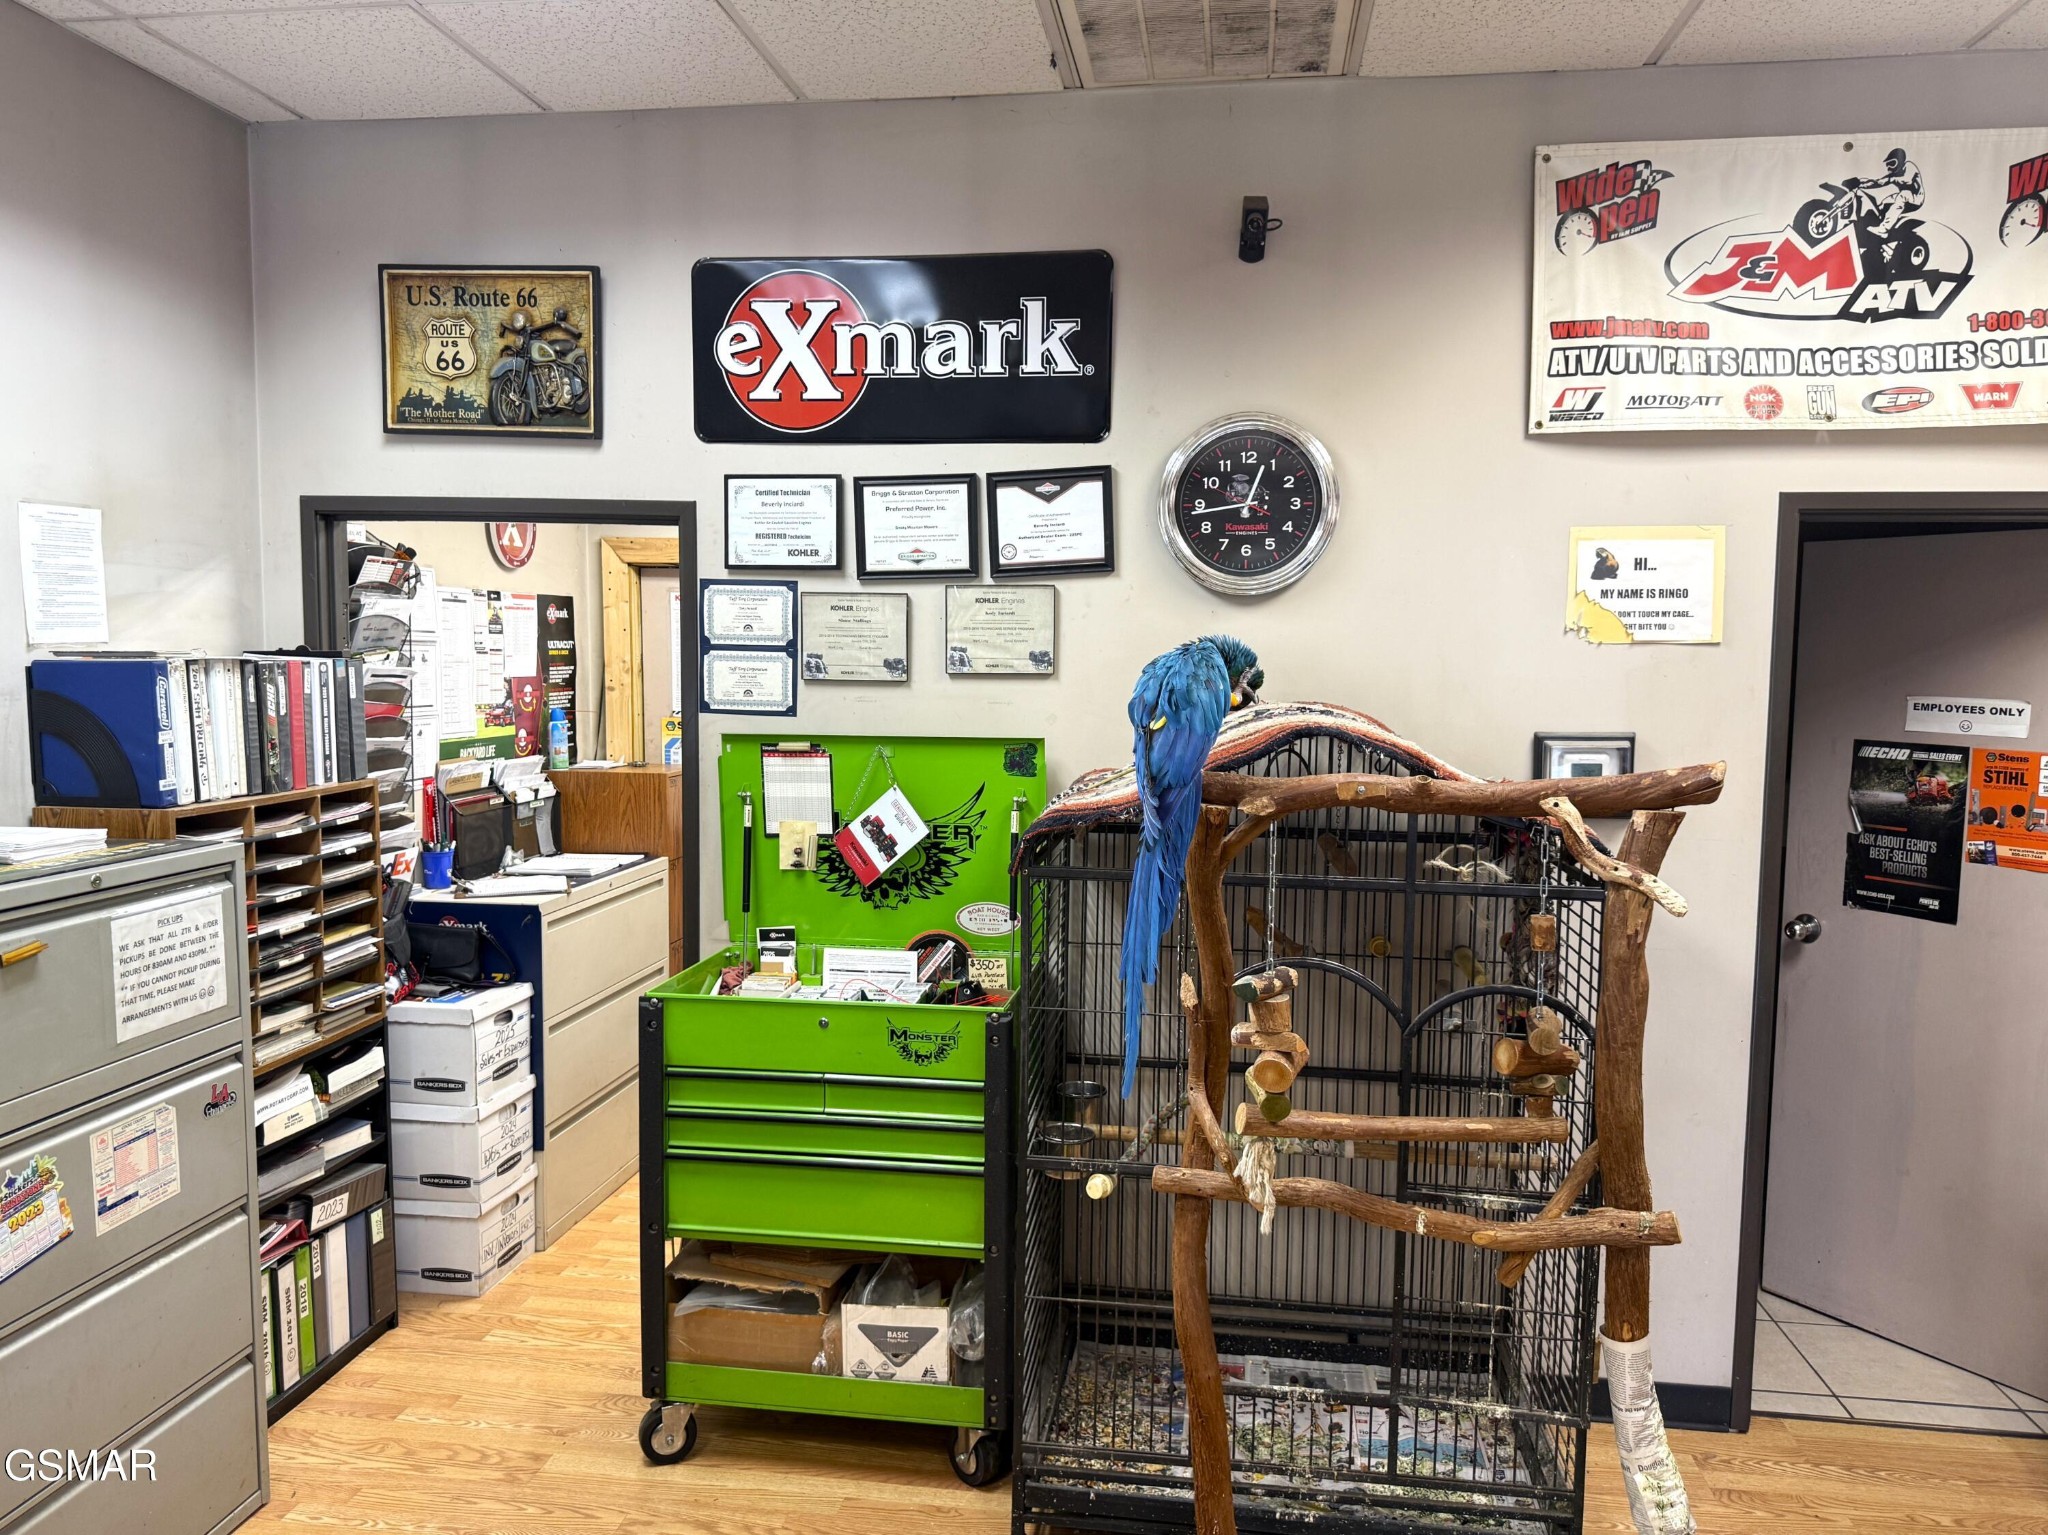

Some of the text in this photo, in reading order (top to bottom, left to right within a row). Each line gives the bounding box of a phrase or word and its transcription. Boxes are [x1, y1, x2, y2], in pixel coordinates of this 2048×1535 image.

[1556, 162, 1636, 215] Wide
[1631, 222, 1653, 233] SUPPLY
[1682, 234, 1860, 296] J&M
[405, 285, 538, 308] U.S. Route 66
[1849, 280, 1956, 315] ATV
[1550, 316, 1710, 340] www.jmatv.com
[1967, 308, 2048, 333] 1-800-3
[431, 324, 465, 336] ROUTE
[440, 340, 459, 348] US
[714, 297, 1085, 402] eXmark
[436, 351, 465, 371] 66
[1547, 336, 2048, 378] ATV/UTV PARTS AND ACCESSORIES SOLD
[1625, 395, 1724, 410] MOTOBATT
[1749, 394, 1777, 403] NGK
[1807, 391, 1836, 415] GUN
[1871, 392, 1931, 408] EPI
[1973, 392, 2009, 402] WARN
[400, 407, 485, 419] "The Mother Road"
[1240, 451, 1257, 463] 12
[1219, 460, 1231, 472] 11
[1270, 459, 1276, 471] 1
[1203, 477, 1219, 489] 10
[1283, 476, 1295, 488] 2
[871, 490, 891, 498] Briggs
[924, 488, 959, 497] Corporation
[1195, 499, 1206, 512] 9
[1290, 498, 1301, 510] 3
[1201, 521, 1212, 533] 8
[1225, 522, 1269, 531] Kawasaki
[1282, 521, 1294, 533] 4
[1219, 538, 1230, 551] 7
[1240, 545, 1252, 557] 6
[1264, 538, 1276, 550] 5
[788, 549, 819, 557] KOHLER
[1633, 557, 1657, 571] HI...
[1600, 588, 1689, 599] MY NAME IS RINGO
[855, 605, 880, 613] Engines
[1001, 597, 1025, 606] Engines
[546, 607, 569, 619] eXmark
[1618, 610, 1694, 618] DON'T TOUCH MY CAGE...
[159, 679, 170, 729] Carswell
[194, 693, 203, 722] SMM
[266, 684, 277, 717] ECHO
[1913, 702, 2025, 717] EMPLOYEES ONLY
[195, 723, 207, 770] PRICING
[486, 744, 496, 758] LIFE
[1868, 746, 1911, 761] ECHO
[1929, 752, 1963, 762] SALES EVENT
[1998, 753, 2030, 763] Stens
[1983, 769, 2029, 787] STIHL
[1858, 833, 1937, 853] ASK ABOUT ECHO'S
[850, 841, 869, 866] Kawasaki
[1869, 846, 1927, 866] BEST-SELLING
[1882, 861, 1928, 879] PRODUCTS
[967, 906, 1010, 918] BOAT HOUSE
[157, 914, 183, 926] PICK UPS
[133, 939, 145, 948] ASK
[148, 934, 164, 944] THAT
[168, 930, 178, 939] ALL
[181, 926, 192, 935] ZTR
[195, 924, 200, 932] &
[203, 919, 219, 930] RIDER
[119, 931, 220, 966] PICKUPS BE DONE BETWEEN THE
[120, 947, 209, 979] HOURS OF 830AM AND 430PM.
[969, 959, 996, 971] $350
[137, 980, 150, 989] YOU
[151, 971, 176, 985] CANNOT
[178, 964, 198, 977] PICKUP
[199, 957, 221, 970] DURING
[121, 978, 196, 1008] THAT TIME, PLEASE MAKE
[122, 993, 198, 1025] ARRANGEMENTS WITH US
[495, 1022, 518, 1048] 2025
[889, 1027, 957, 1044] MONSTER
[417, 1081, 463, 1089] BANKERS BOX
[256, 1086, 309, 1115] WWW.ROTARYCORP.COM
[500, 1117, 518, 1140] 2024
[422, 1177, 468, 1186] BANKERS BOX
[4, 1178, 34, 1201] Stickers
[8, 1199, 44, 1234] 2023
[316, 1197, 344, 1224] 2023
[312, 1243, 320, 1273] 2019
[424, 1271, 469, 1280] BANKERS BOX
[284, 1287, 292, 1315] SMM
[299, 1283, 308, 1313] 2018
[887, 1331, 909, 1339] BASIC
